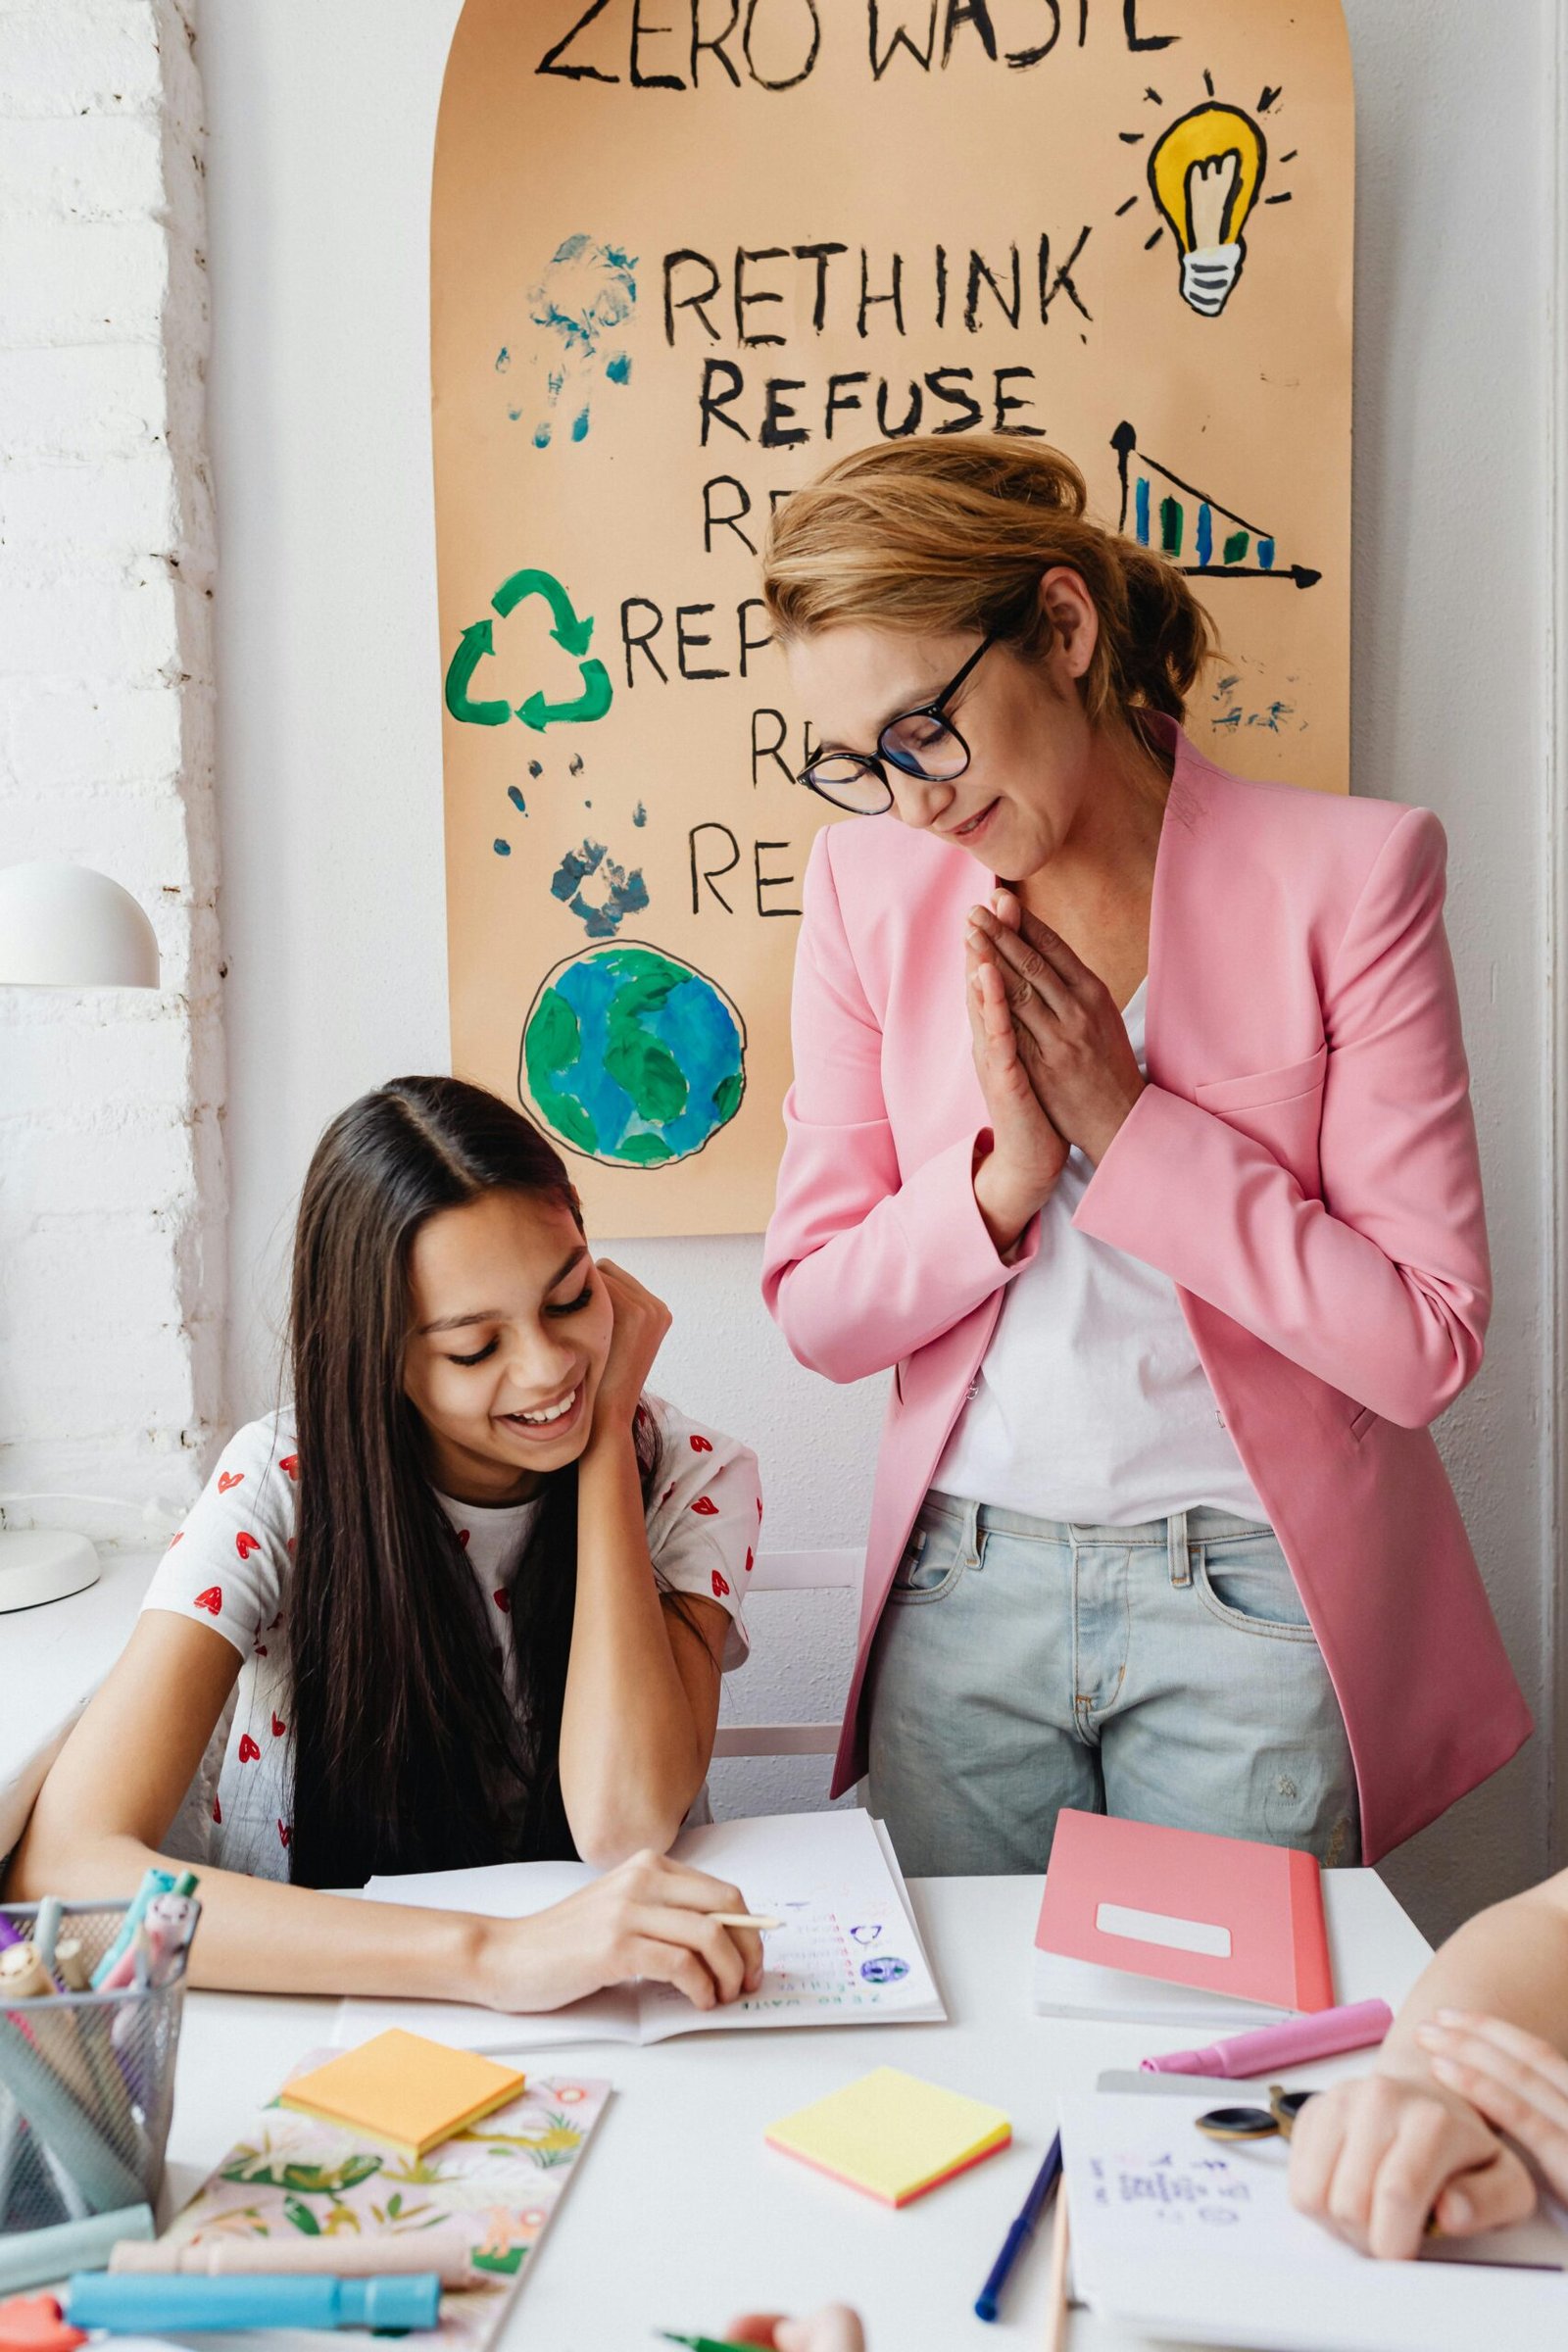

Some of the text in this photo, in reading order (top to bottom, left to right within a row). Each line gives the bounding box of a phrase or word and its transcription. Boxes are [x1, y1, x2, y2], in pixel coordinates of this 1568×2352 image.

[535, 0, 820, 90] ZERO
[663, 225, 1093, 349] RETHINK
[699, 358, 1047, 449] REFUSE
